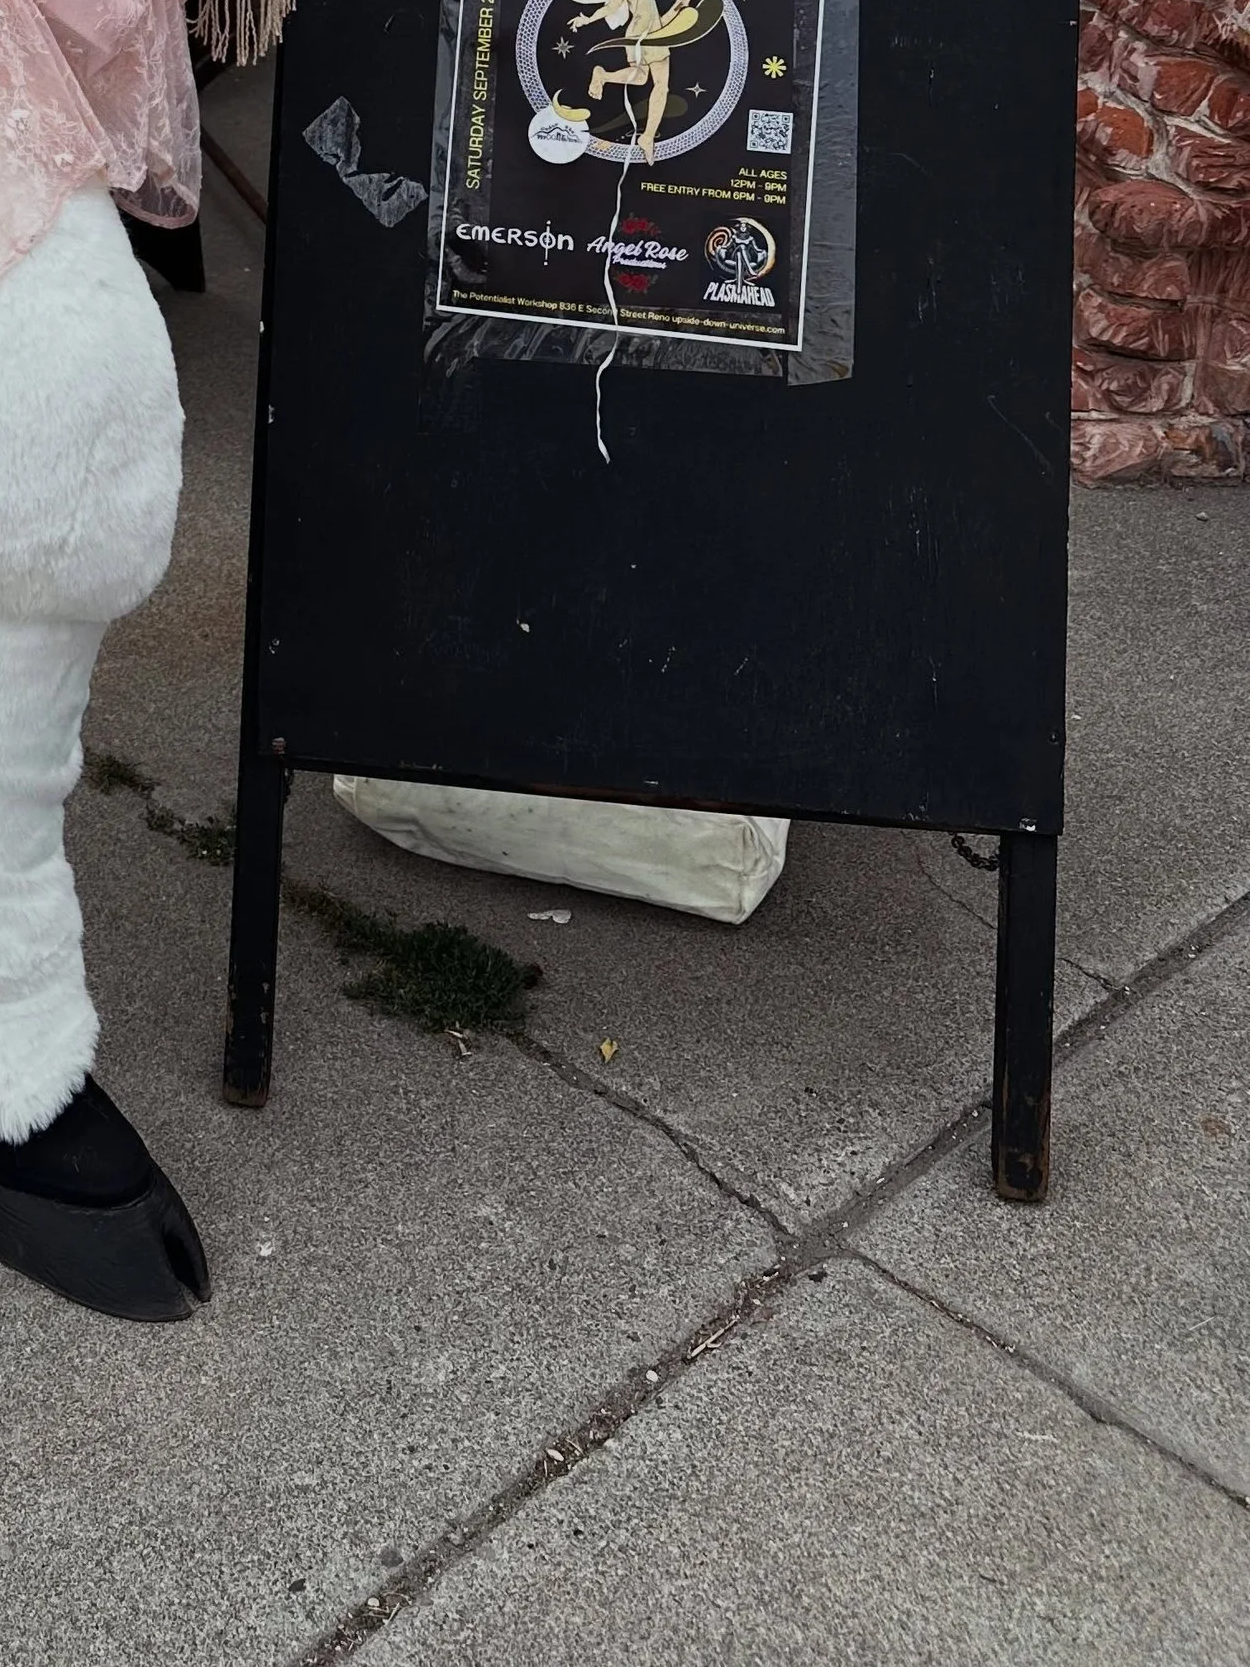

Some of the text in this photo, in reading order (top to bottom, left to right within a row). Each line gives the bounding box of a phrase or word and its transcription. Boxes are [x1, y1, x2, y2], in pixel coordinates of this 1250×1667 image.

[473, 7, 494, 101] SEPTEMBER
[466, 104, 486, 190] SATURDAY
[730, 179, 756, 189] 12PM
[738, 167, 788, 180] ALL AGES
[640, 182, 666, 193] FREE
[667, 185, 700, 196] ENTRY
[702, 188, 731, 199] FROM
[733, 191, 755, 202] 6PM
[586, 236, 689, 262] Angel Rose
[452, 289, 468, 300] The
[517, 297, 558, 311] Workshop
[586, 305, 617, 317] Secon
[619, 308, 647, 319] Street
[703, 282, 776, 308] PLASMAHEAD
